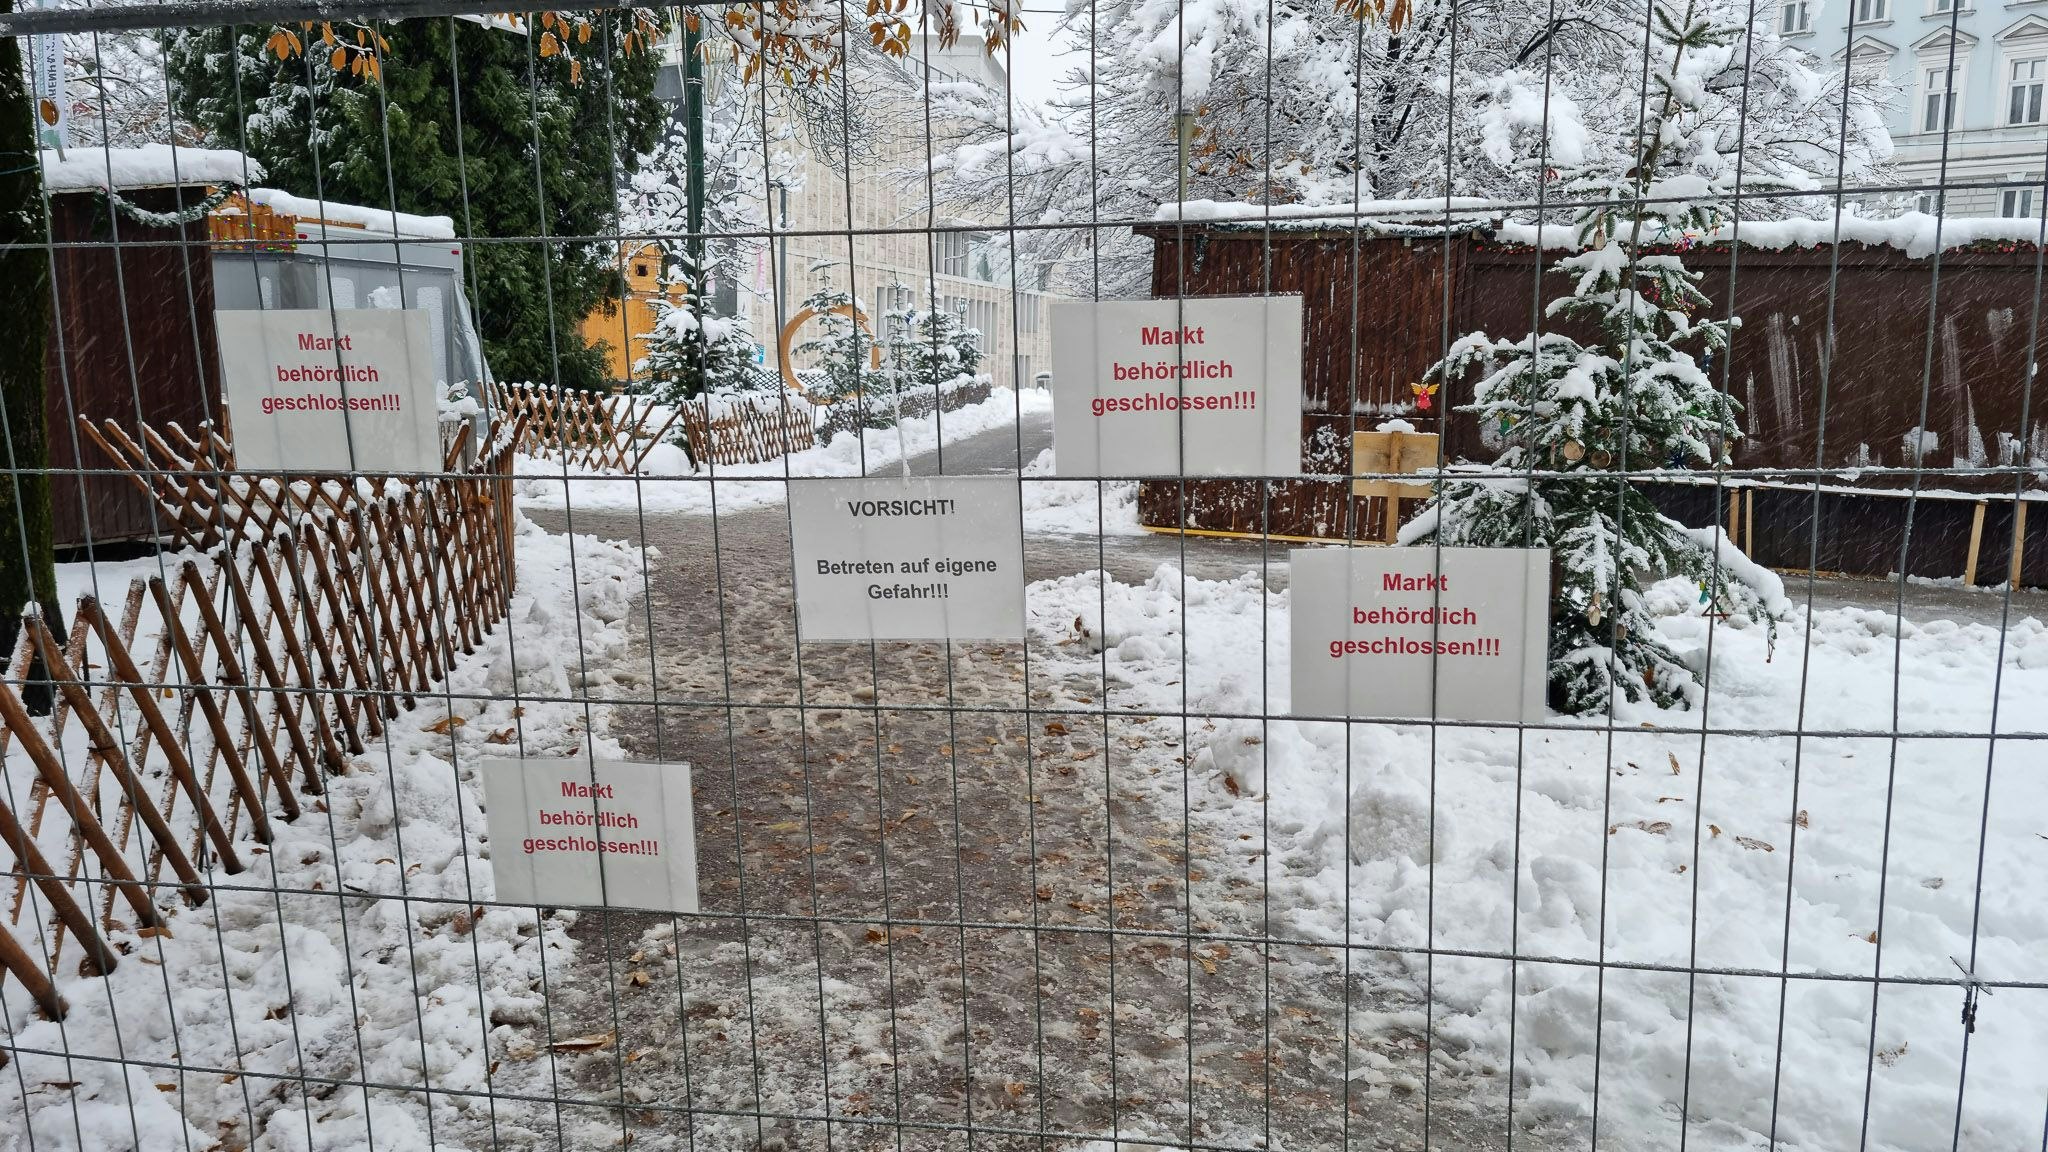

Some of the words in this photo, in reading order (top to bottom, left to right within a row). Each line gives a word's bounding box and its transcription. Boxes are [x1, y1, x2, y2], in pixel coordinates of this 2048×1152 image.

[298, 333, 352, 351] Markt
[1141, 326, 1205, 346] Markt
[277, 365, 379, 382] behördlich
[1113, 360, 1233, 381] behördlich
[261, 394, 400, 415] geschlossen!!!
[1091, 391, 1256, 417] geschlossen!!!
[848, 499, 956, 517] VORSICHT!
[817, 559, 895, 575] Betreten
[900, 558, 930, 573] auf
[934, 559, 998, 577] eigene
[868, 583, 949, 600] Gefahr!!!
[1383, 572, 1448, 592] Markt
[1353, 607, 1477, 625] behördlich
[1330, 637, 1500, 658] geschlossen!!!
[561, 781, 613, 799] Markt
[540, 810, 638, 829] behördlich
[523, 836, 658, 856] geschlossen!!!
